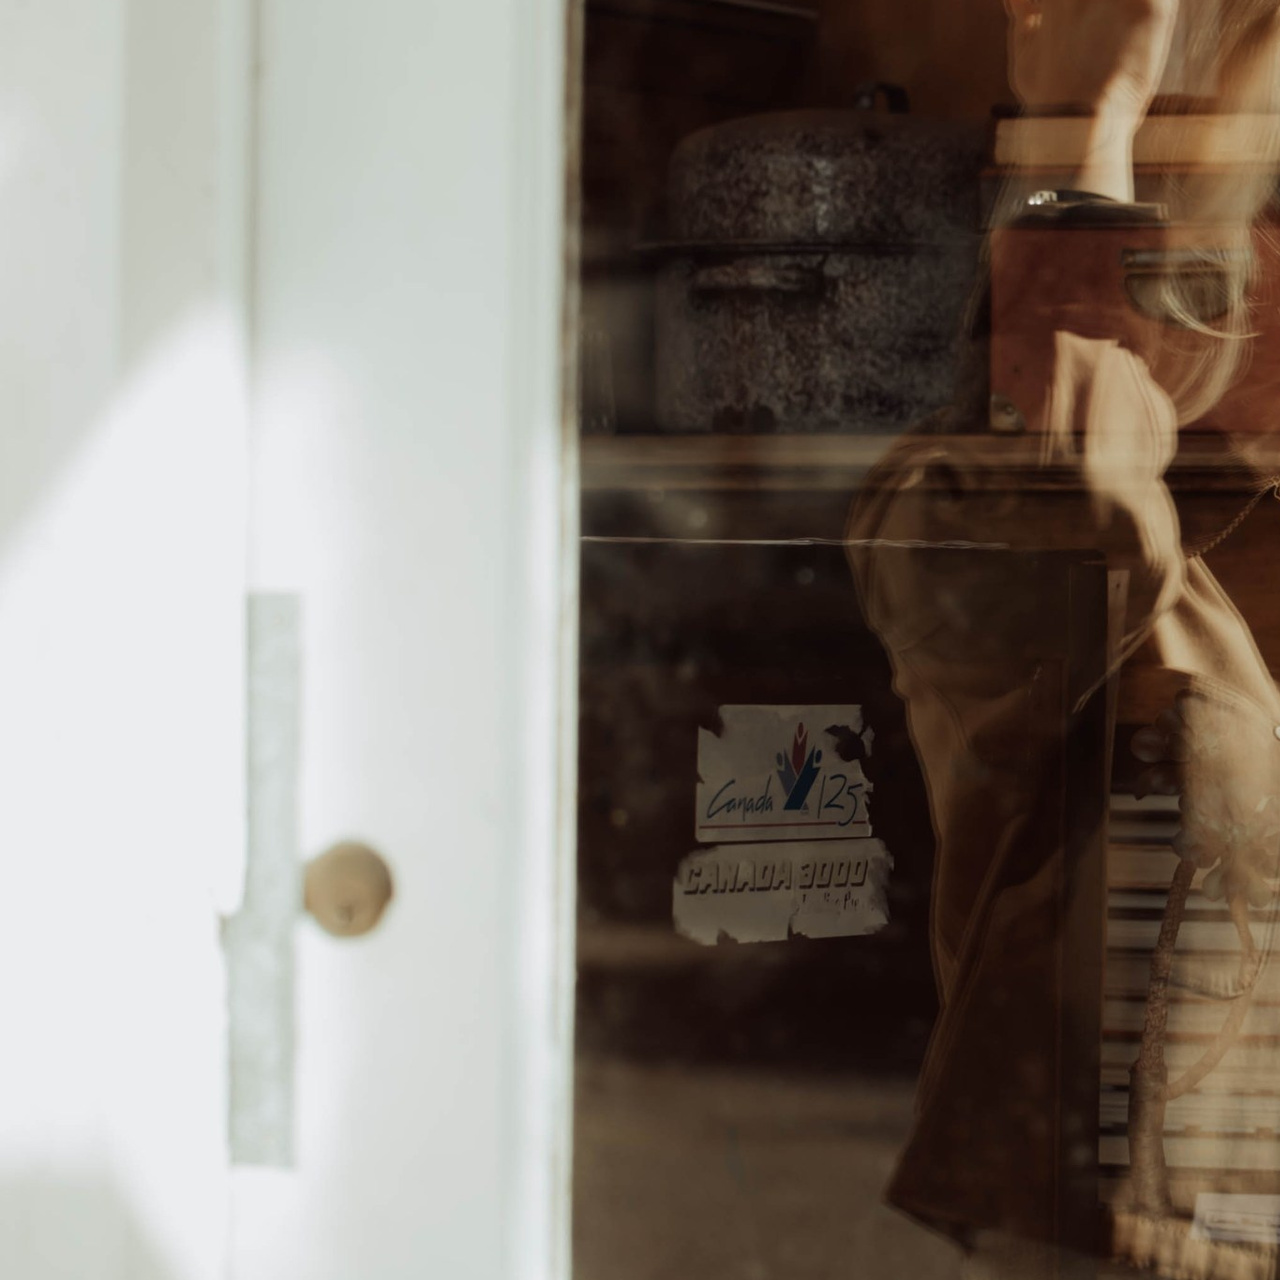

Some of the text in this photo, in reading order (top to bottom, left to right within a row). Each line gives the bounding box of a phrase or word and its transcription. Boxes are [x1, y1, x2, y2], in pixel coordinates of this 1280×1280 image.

[706, 773, 863, 827] Canada 125
[683, 860, 794, 896] CANADA
